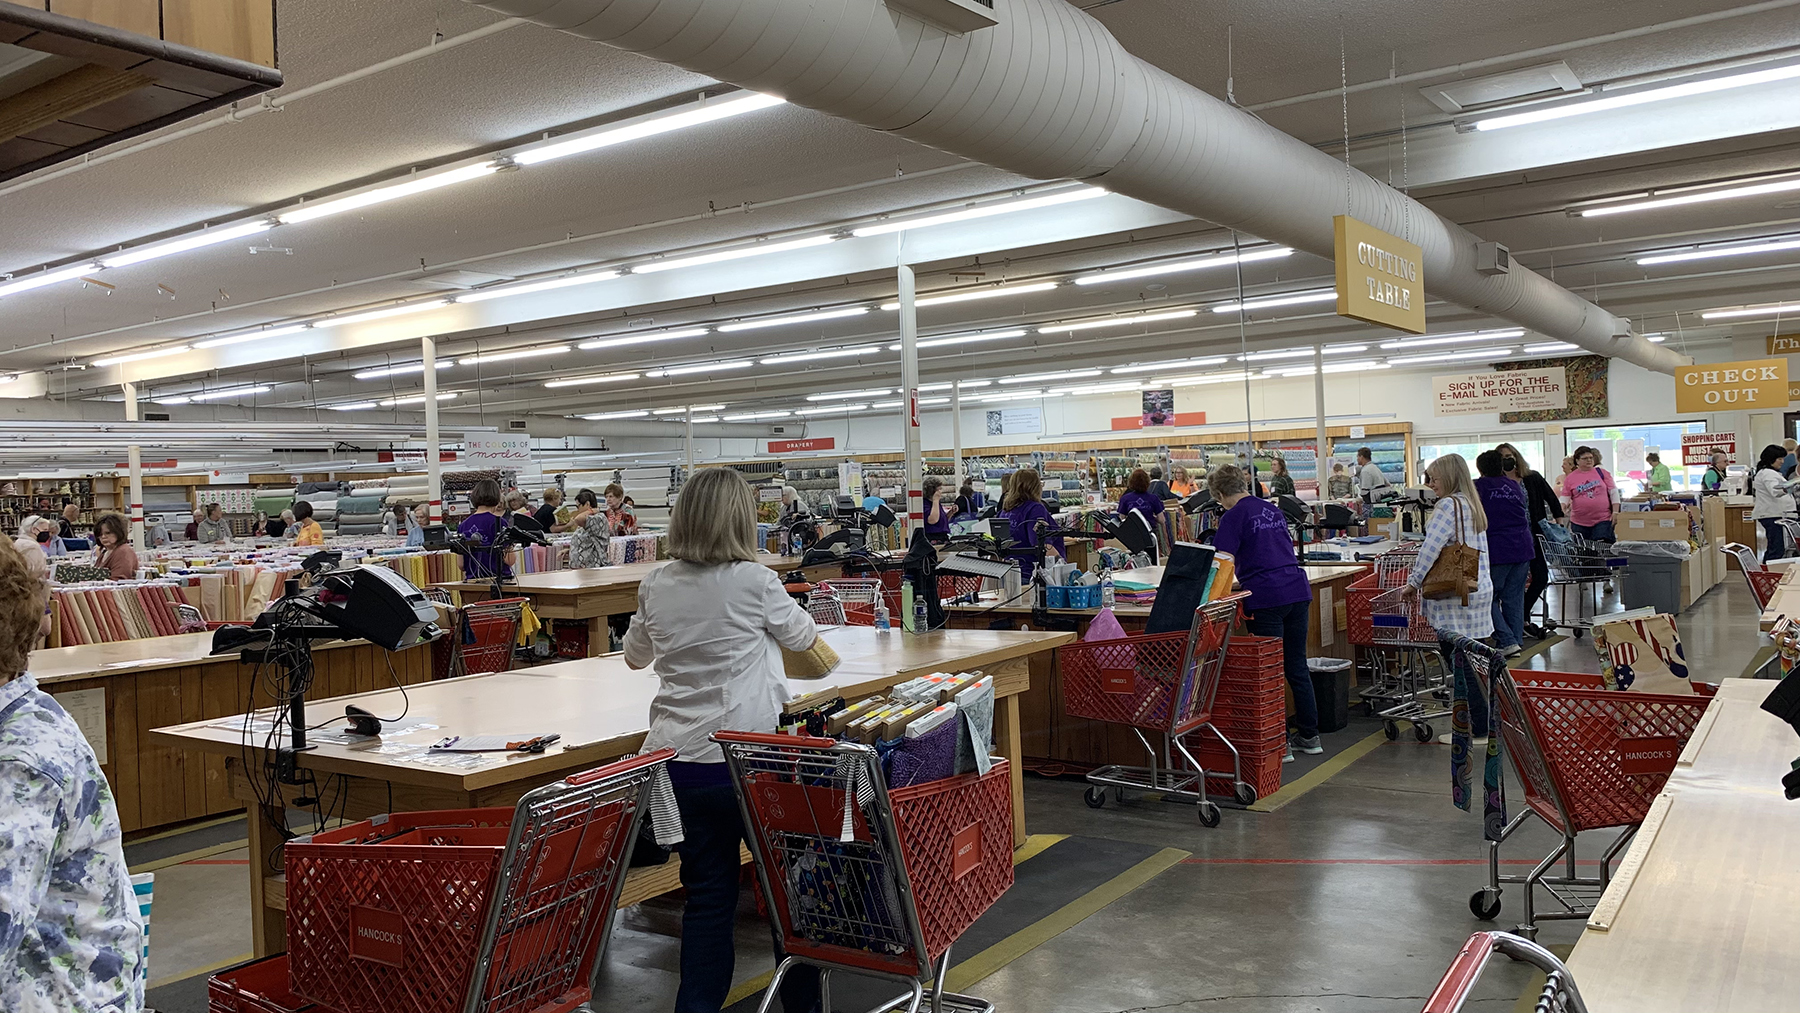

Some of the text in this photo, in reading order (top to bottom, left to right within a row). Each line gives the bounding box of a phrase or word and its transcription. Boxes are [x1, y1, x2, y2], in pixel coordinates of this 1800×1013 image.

[1358, 241, 1416, 283] CUTTING
[1366, 276, 1411, 312] TABLE
[1448, 376, 1550, 392] SIGN UP FOR THE
[1683, 366, 1779, 386] CHECK
[1440, 384, 1560, 400] E-MAIL NEWSLETTER
[1703, 388, 1759, 404] OUT
[1682, 433, 1735, 444] SHOPPING CARTS
[469, 450, 529, 458] moda
[1688, 445, 1711, 455] MUST
[1685, 454, 1711, 463] INSID
[1625, 750, 1672, 760] HANCOCK'S
[357, 925, 402, 945] HANCOCK'S
